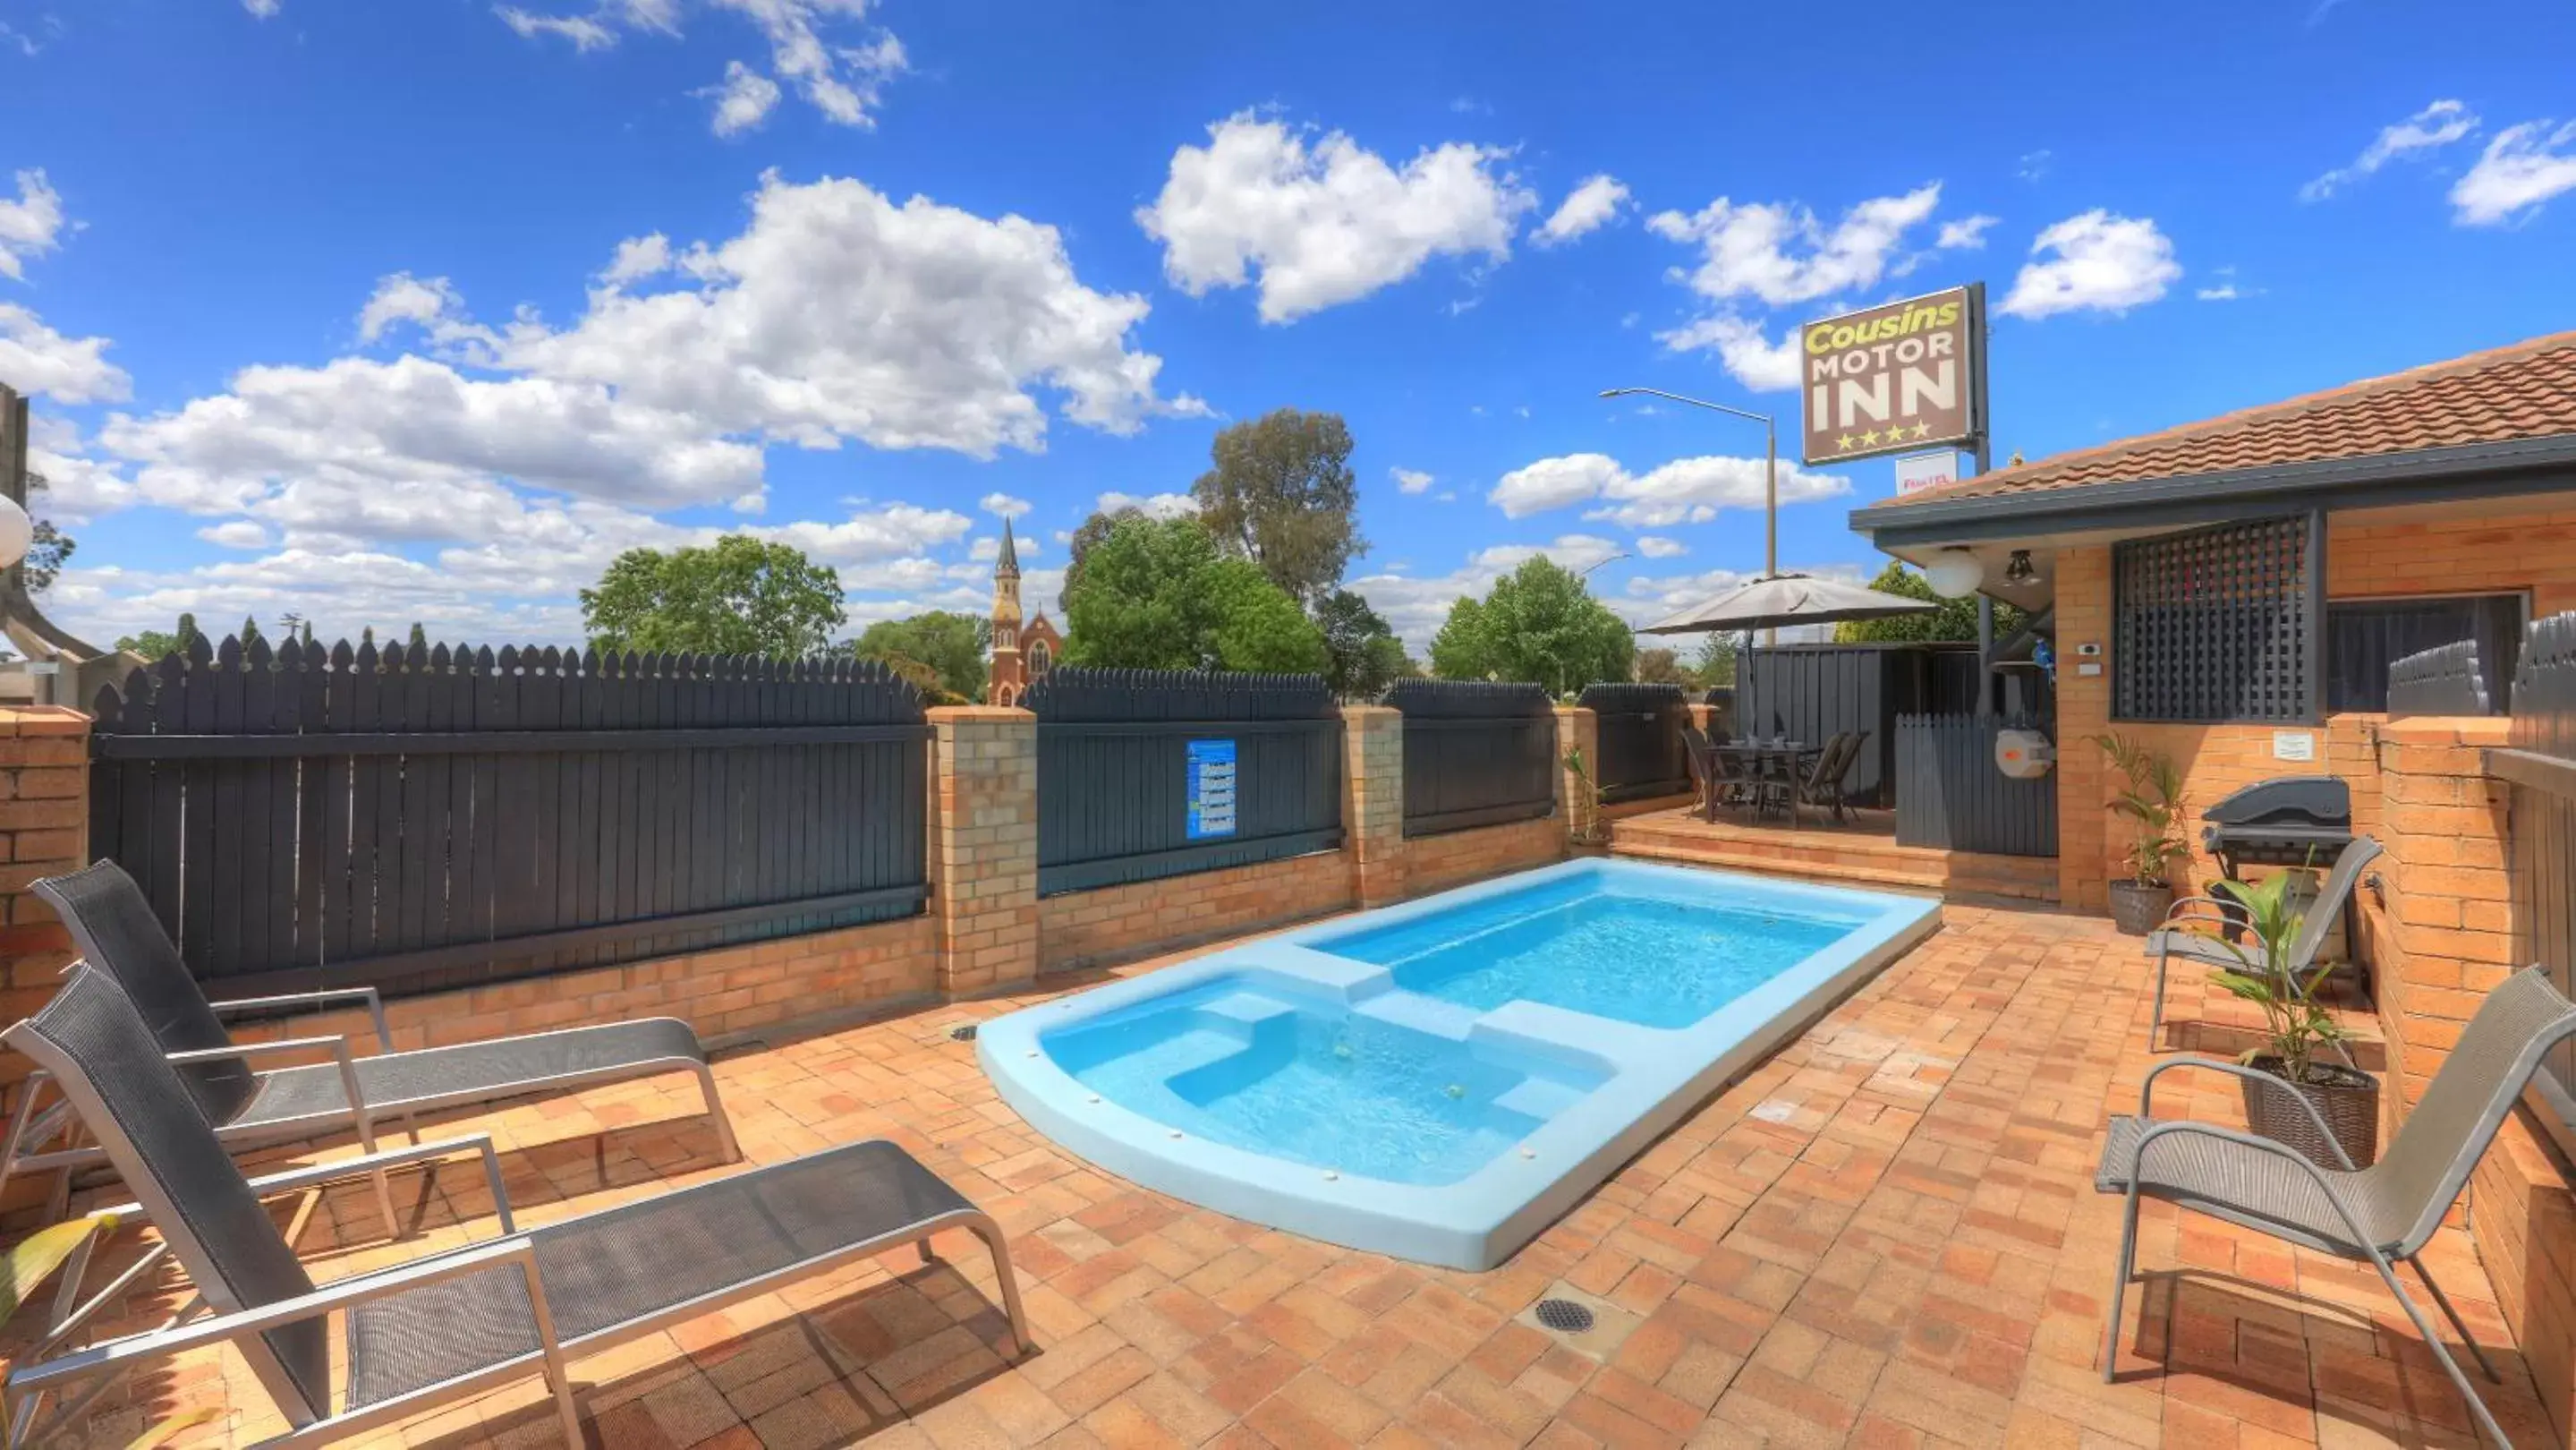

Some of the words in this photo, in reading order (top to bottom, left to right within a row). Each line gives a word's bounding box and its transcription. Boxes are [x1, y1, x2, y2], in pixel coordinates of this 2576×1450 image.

[1805, 302, 1961, 354] Cousins
[1812, 331, 1954, 382] MOTOR
[1813, 358, 1957, 433] INN
